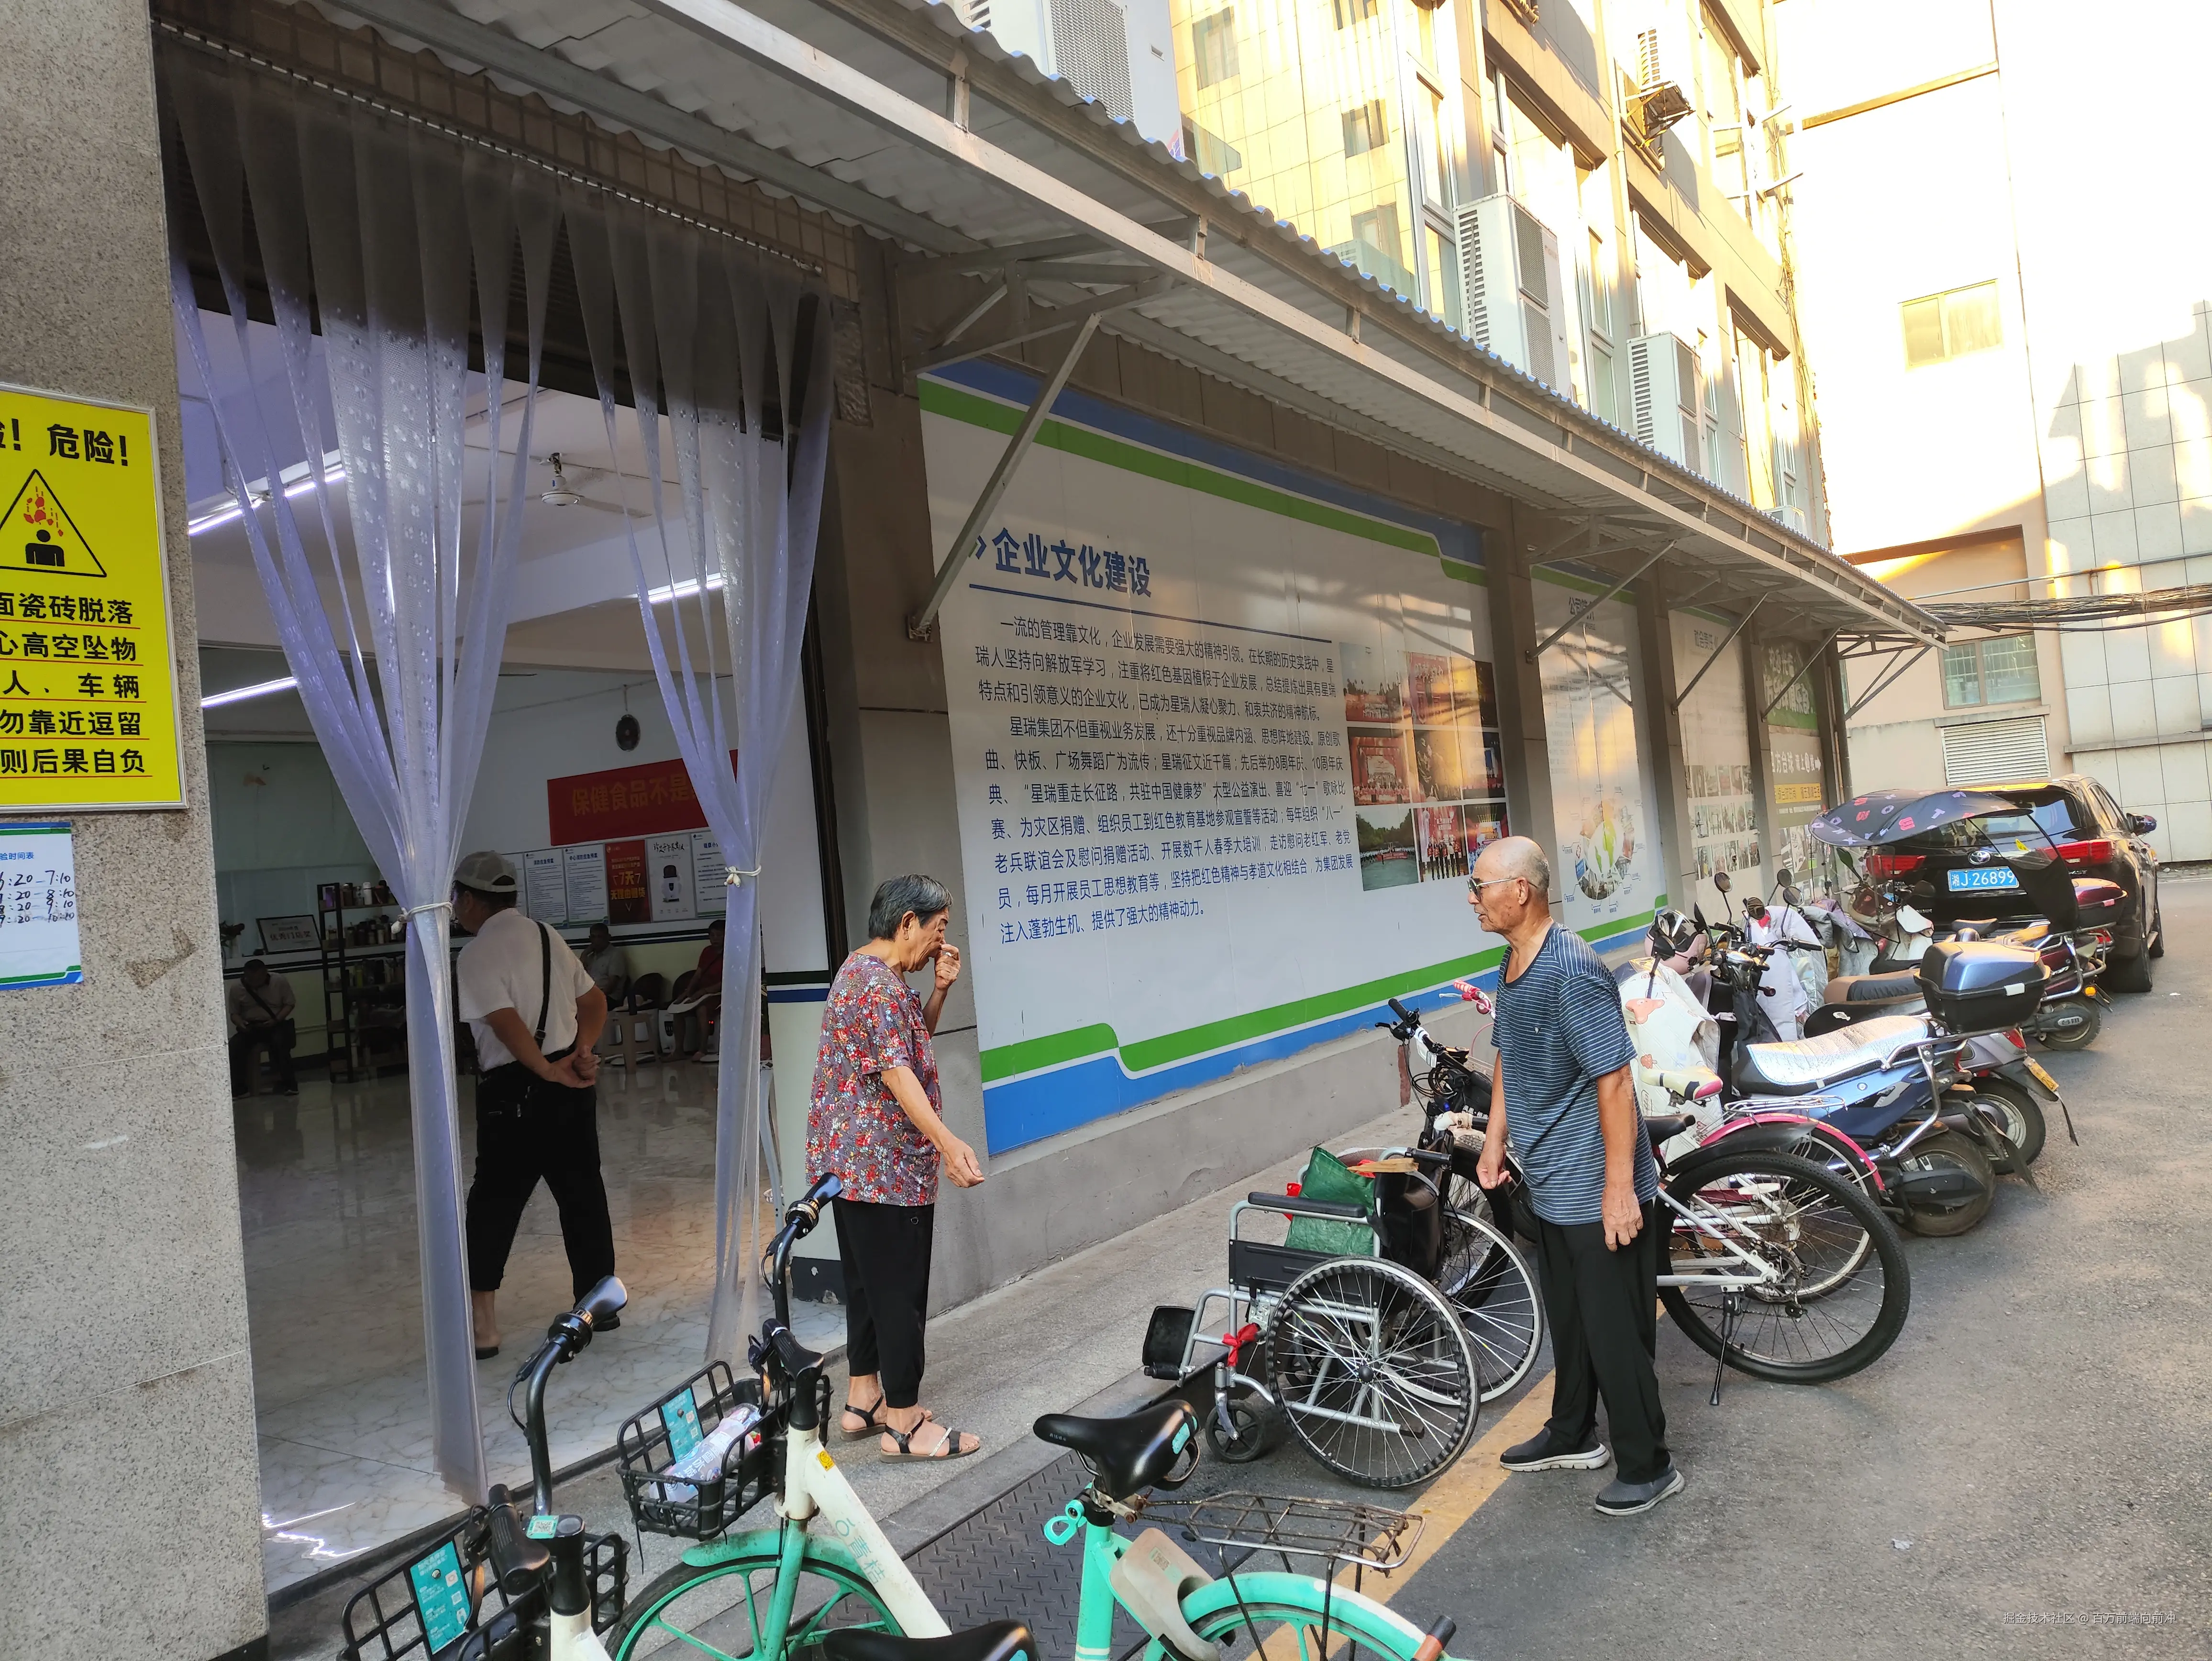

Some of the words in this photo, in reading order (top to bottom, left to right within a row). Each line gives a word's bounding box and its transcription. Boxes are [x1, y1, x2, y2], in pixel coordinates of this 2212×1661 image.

[992, 527, 1151, 597] 企业文化建设
[0, 591, 133, 625] 面瓷砖脱落
[0, 630, 136, 662] 心高空坠物
[0, 709, 141, 736] 勿靠近逗留
[1, 748, 145, 774] 则后果自负
[573, 773, 697, 816] 保健食品不是
[1000, 898, 1205, 944] 注入蓬勃生机、提供了强大的精神动力。
[849, 1535, 885, 1585] 青桔
